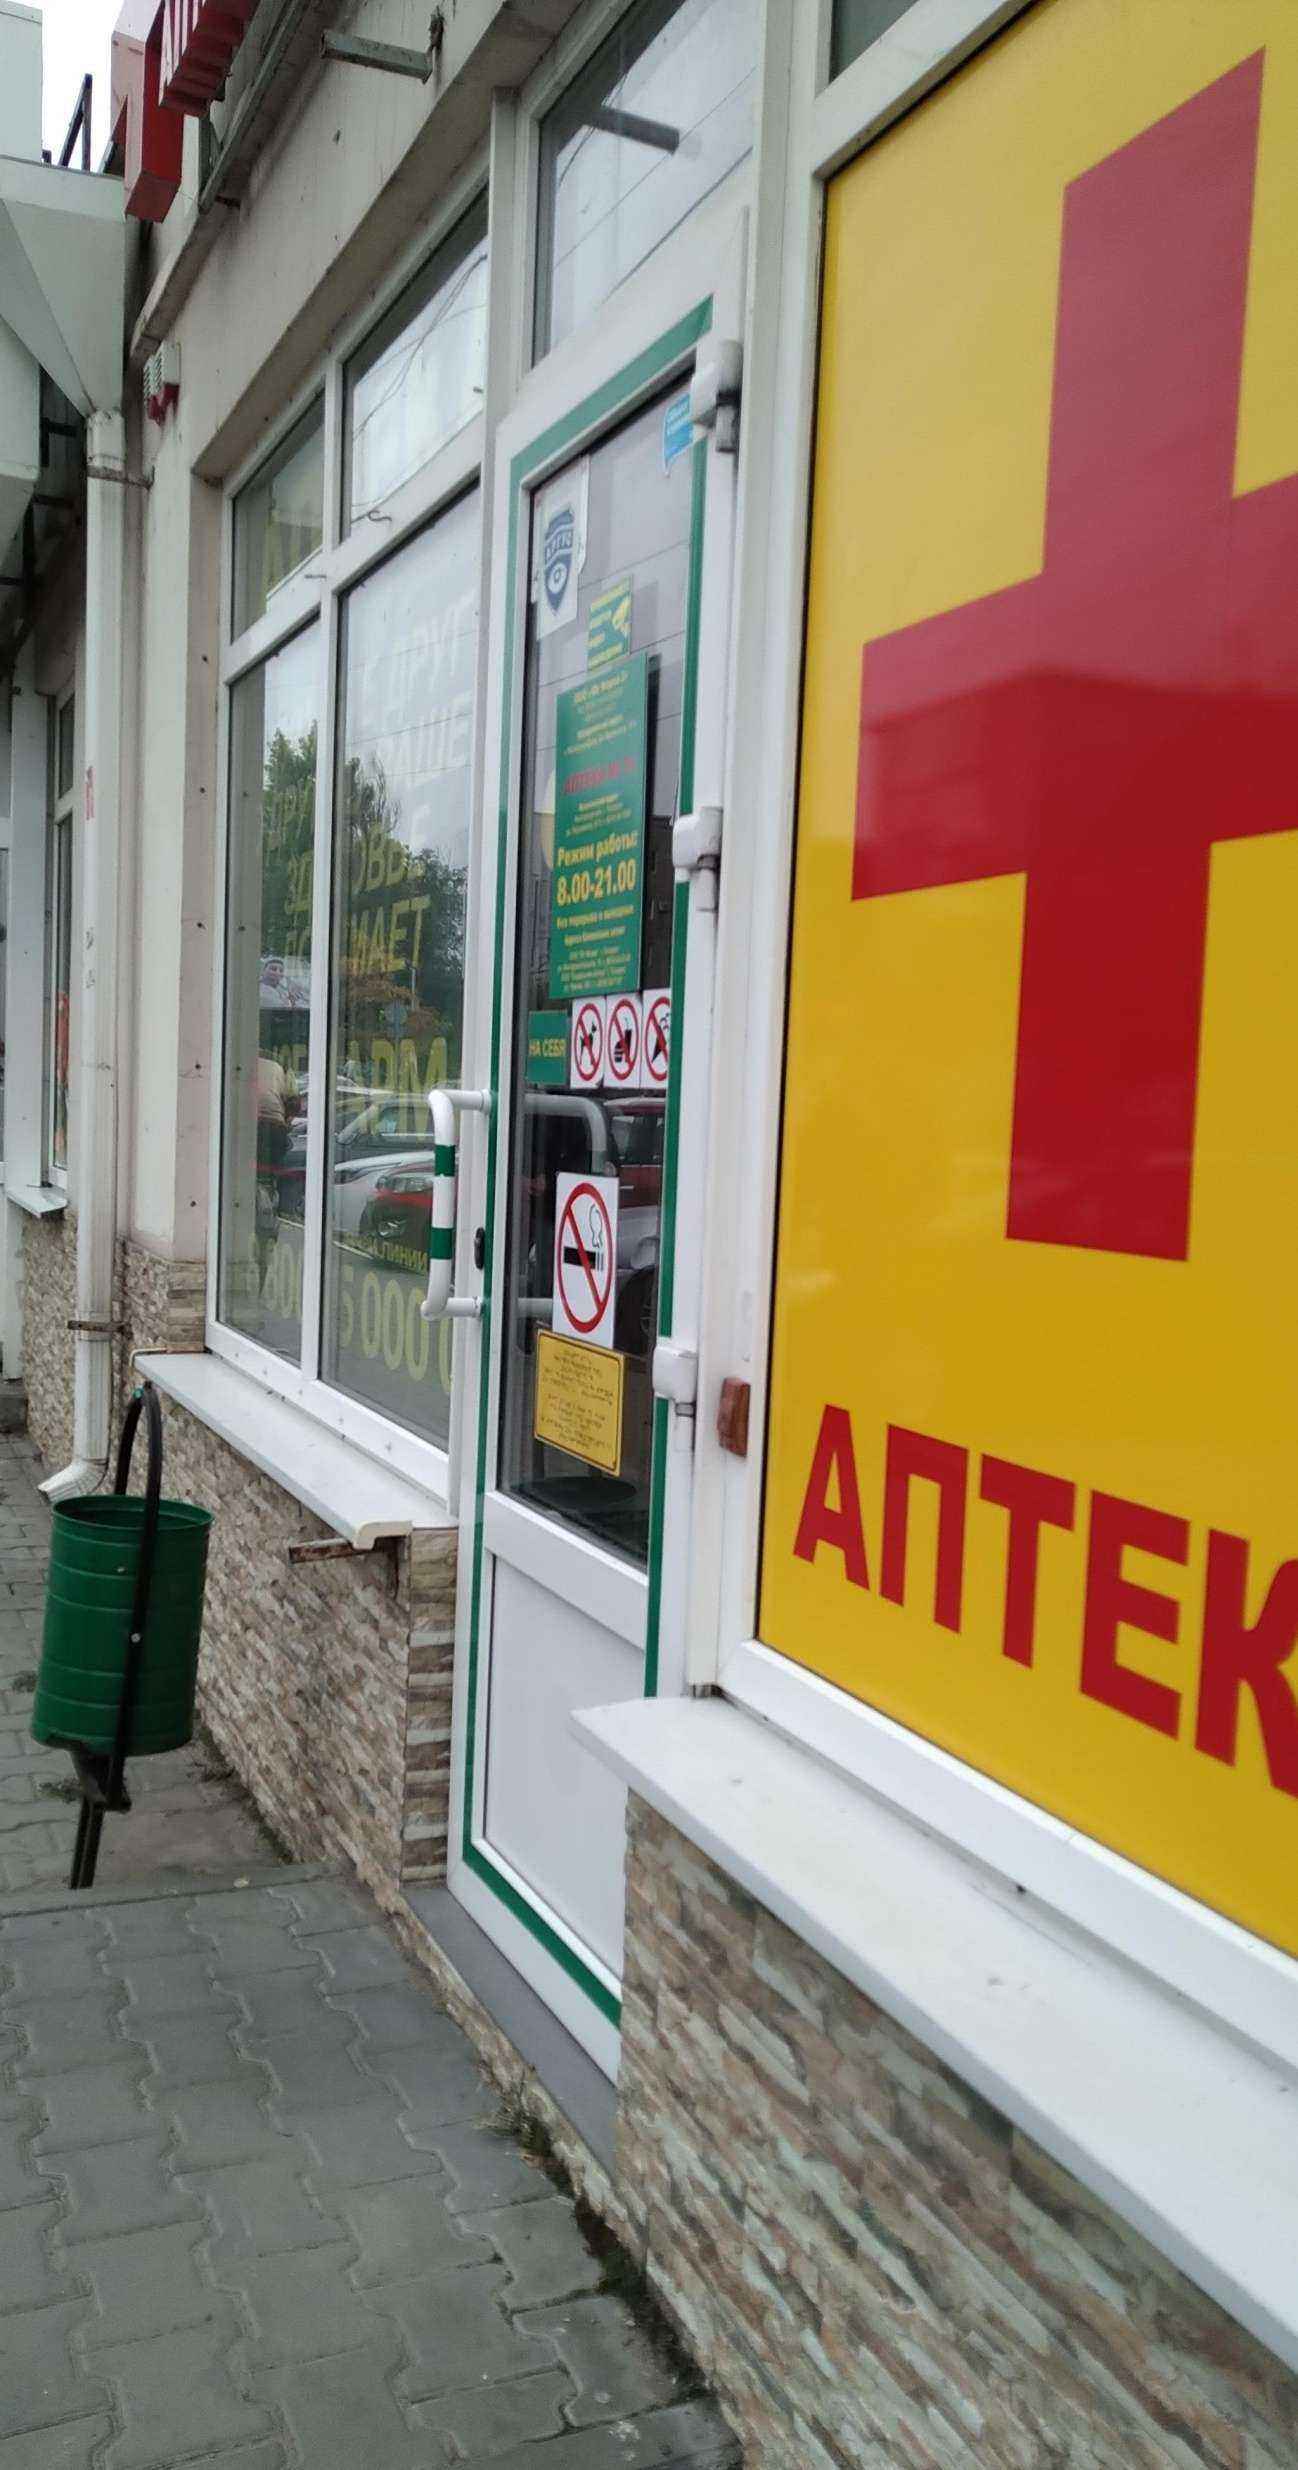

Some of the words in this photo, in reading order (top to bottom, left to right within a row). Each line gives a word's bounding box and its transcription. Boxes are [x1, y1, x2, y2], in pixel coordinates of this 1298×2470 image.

[557, 843, 594, 868] Режим
[556, 857, 637, 908] 8.00-21.00
[528, 1038, 541, 1057] НА
[543, 1038, 568, 1058] СЕБЯ
[793, 1404, 1298, 1802] АПТЕК
